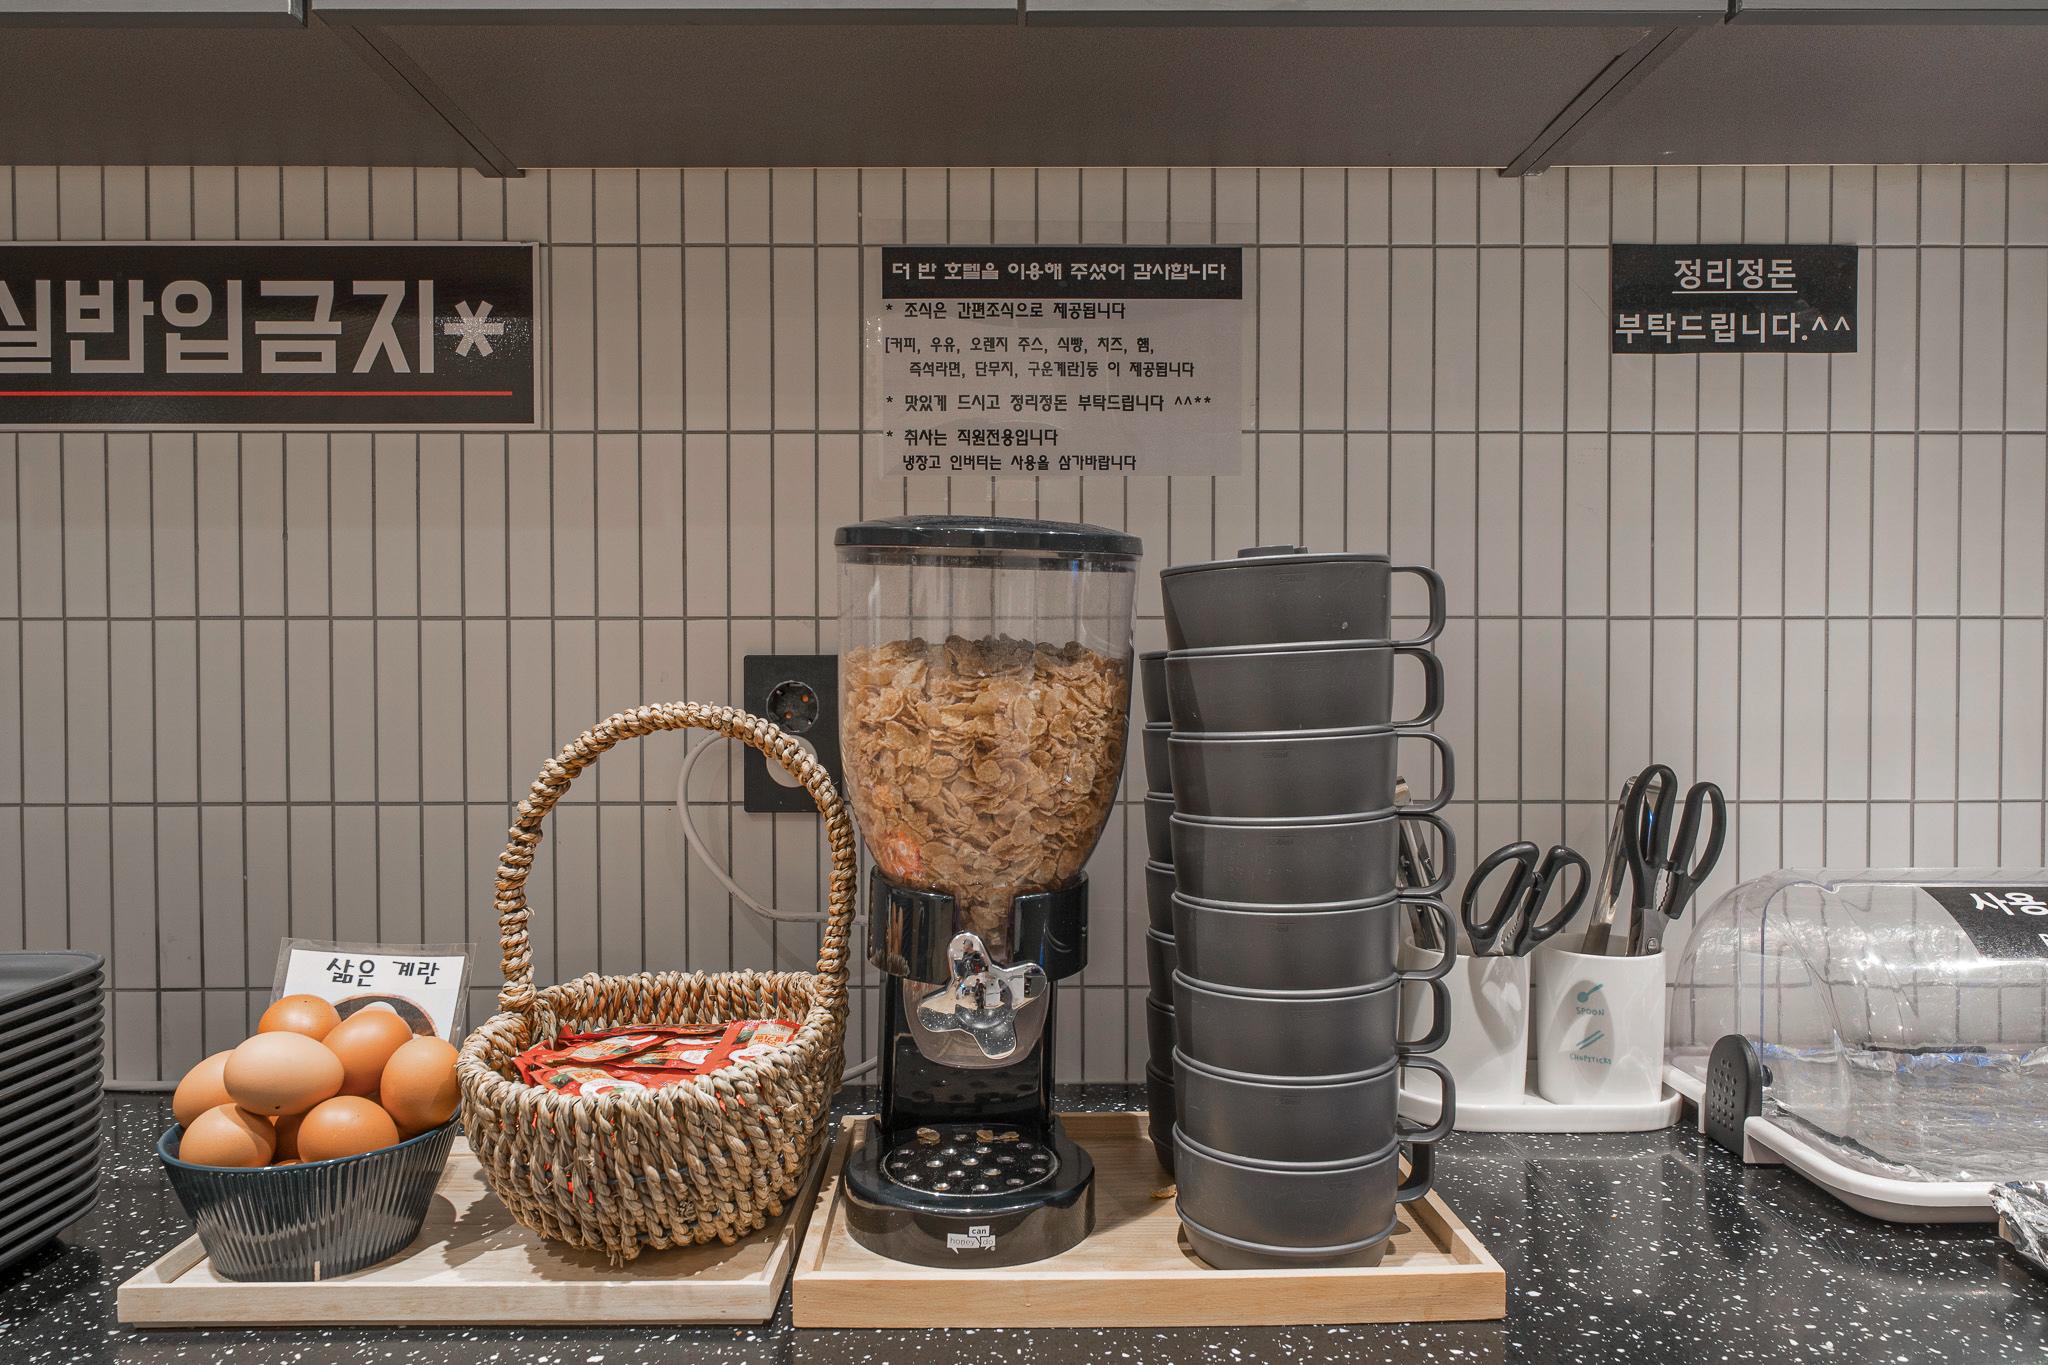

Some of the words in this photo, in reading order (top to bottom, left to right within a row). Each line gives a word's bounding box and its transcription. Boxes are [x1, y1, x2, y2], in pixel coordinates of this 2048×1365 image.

[893, 263, 909, 279] 더
[919, 263, 936, 279] 반
[945, 262, 998, 279] 호텔을
[1008, 263, 1061, 280] 이용해
[1071, 264, 1124, 280] 주셨어
[1134, 263, 1226, 280] 감사합니다
[1674, 259, 1795, 289] 정리정돈
[905, 302, 947, 319] 조식은
[957, 303, 1043, 319] 간편조식으로
[1053, 303, 1126, 319] 제공됩니다
[930, 337, 960, 354] 우유,
[970, 337, 1007, 352] 오렌지
[1018, 337, 1047, 354] 주스,
[1057, 337, 1087, 354] 식빵,
[1098, 337, 1127, 354] 치즈,
[1137, 337, 1153, 354] 햄,
[910, 362, 965, 378] 즉석라면,
[976, 361, 1018, 378] 단무지,
[1108, 362, 1119, 377] 이
[1129, 362, 1194, 377] 제공됩니다
[905, 395, 946, 411] 맛있게
[958, 395, 1000, 411] 드시고
[1010, 395, 1067, 412] 정리정돈
[1078, 395, 1164, 412] 부탁드립니다
[904, 429, 947, 446] 취사는
[958, 429, 1058, 446] 직원전용입니다
[903, 455, 941, 471] 냉장고
[950, 455, 1001, 470] 인버터는
[1011, 455, 1049, 471] 사용을
[1059, 455, 1136, 470] 삼가바랍니다
[326, 957, 375, 987] 삶은
[392, 961, 440, 985] 계란
[1575, 1007, 1605, 1016] SPOON
